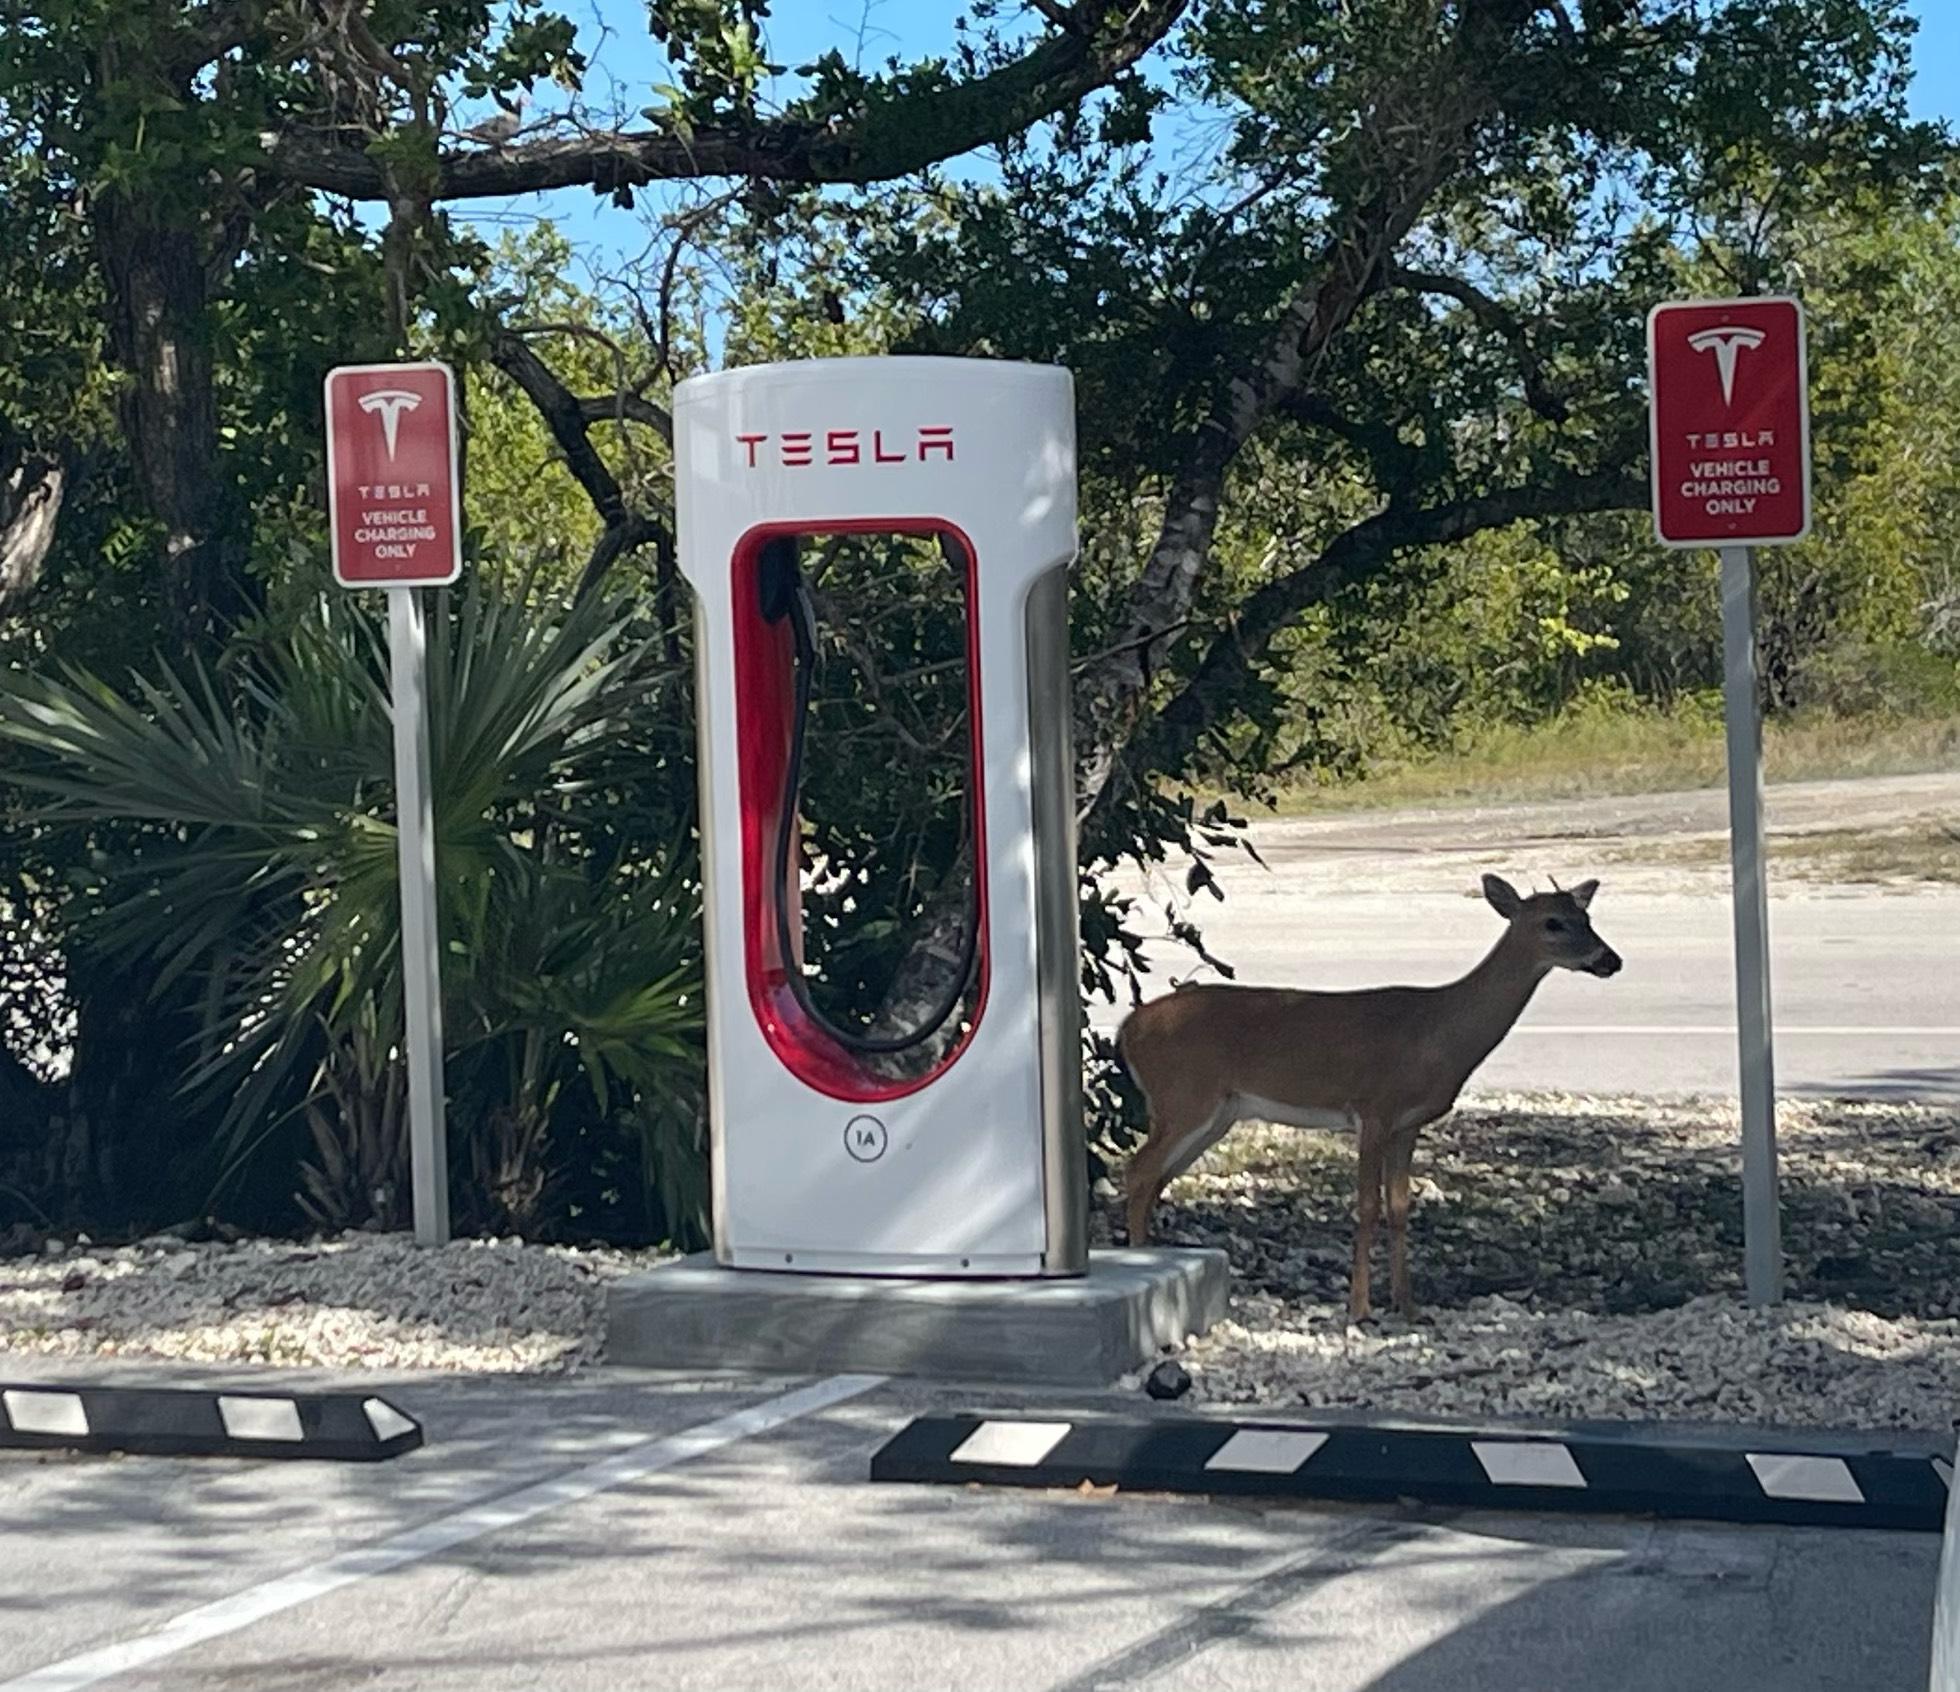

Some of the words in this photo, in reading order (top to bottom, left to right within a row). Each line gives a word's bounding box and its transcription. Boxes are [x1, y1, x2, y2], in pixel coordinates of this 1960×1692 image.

[736, 427, 954, 468] TESLA
[1686, 430, 1774, 449] TESLA
[1690, 460, 1770, 478] VEHICLE
[358, 484, 430, 499] TESLA
[1681, 478, 1780, 498] CHARGING
[1706, 499, 1757, 516] ONLY
[362, 509, 427, 526] VEHICLE
[354, 526, 436, 543] CHARGING
[375, 544, 417, 559] ONLY
[856, 1130, 876, 1147] 1A
